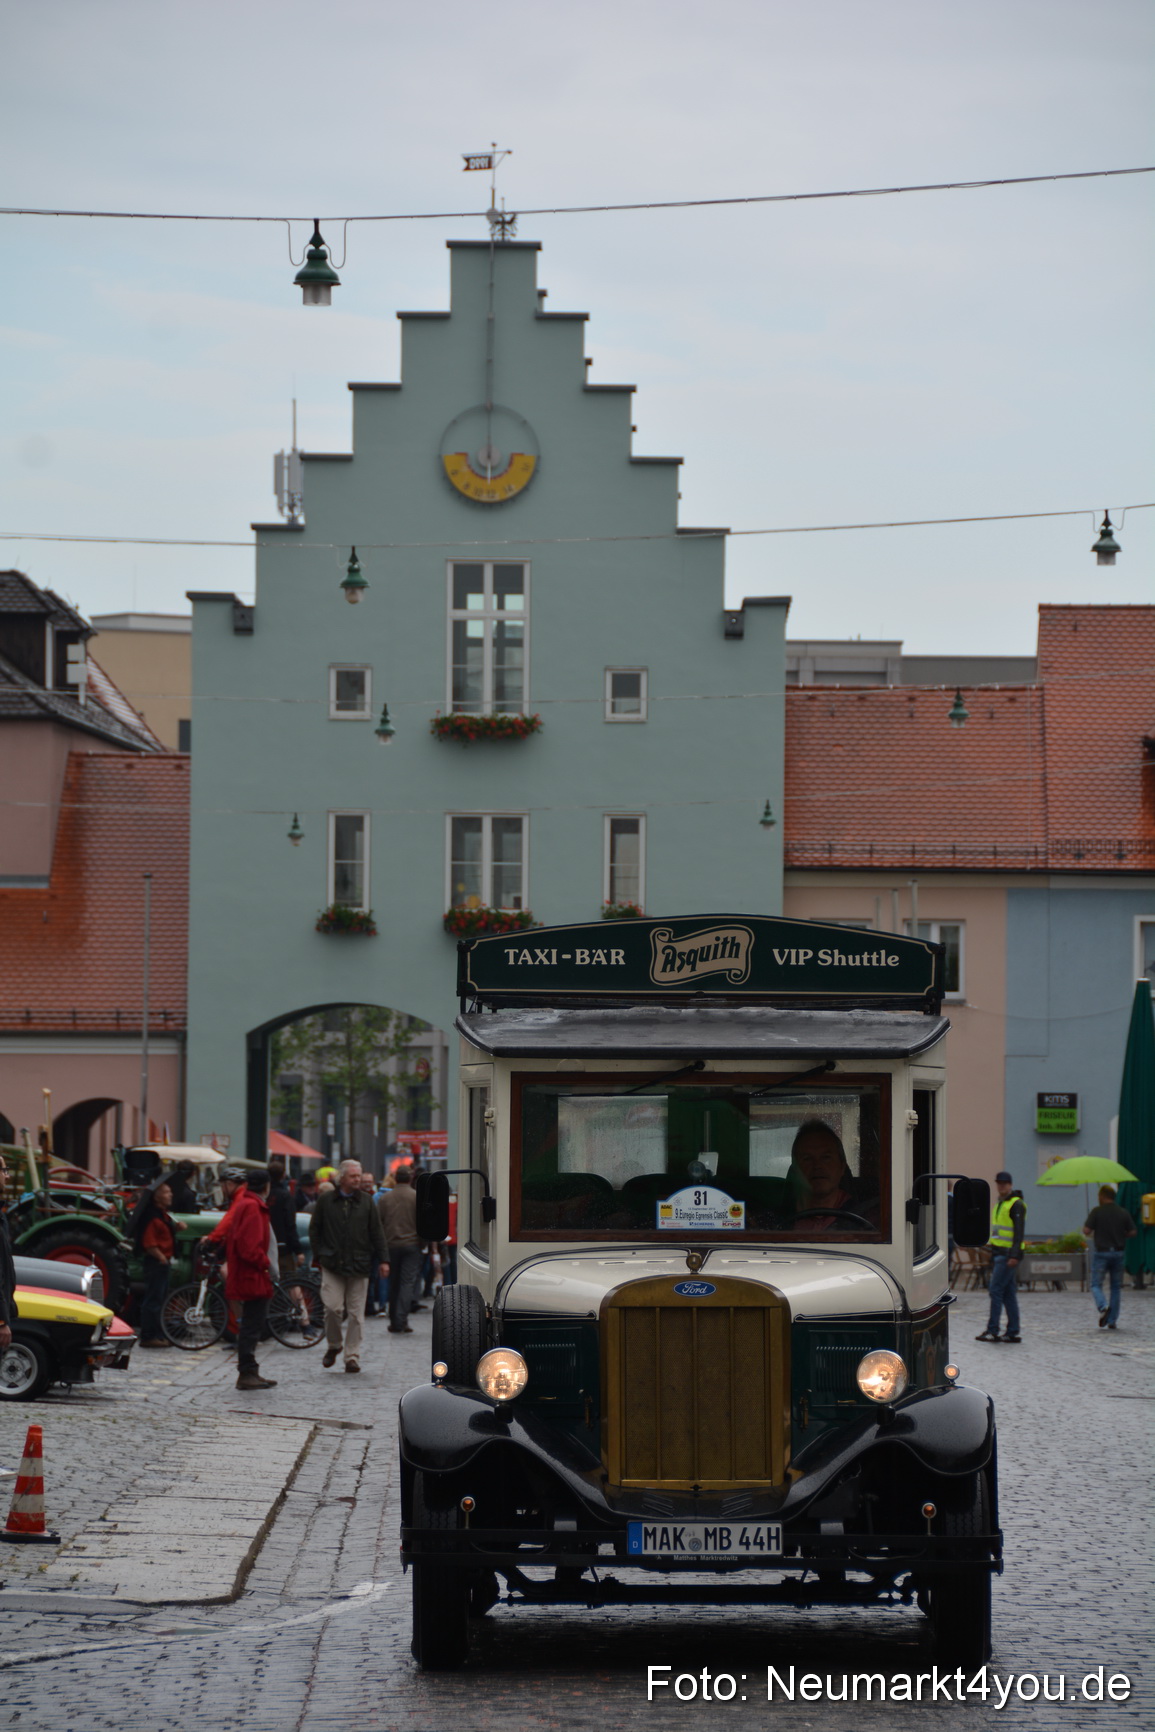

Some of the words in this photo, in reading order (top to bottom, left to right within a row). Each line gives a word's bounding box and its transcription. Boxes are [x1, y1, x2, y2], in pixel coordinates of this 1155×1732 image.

[504, 948, 626, 966] TAXI-BÄR
[659, 936, 741, 974] Asquith
[772, 948, 815, 966] VIP
[817, 948, 900, 967] Shuttle
[1039, 1111, 1076, 1119] FRISEUR
[694, 1190, 708, 1206] 31
[696, 1211, 713, 1221] Egrensis
[714, 1208, 728, 1219] Classic
[682, 1283, 708, 1294] Ford
[632, 1541, 639, 1549] D
[644, 1527, 686, 1551] MAK
[704, 1527, 732, 1551] MB
[738, 1527, 780, 1551] 44H
